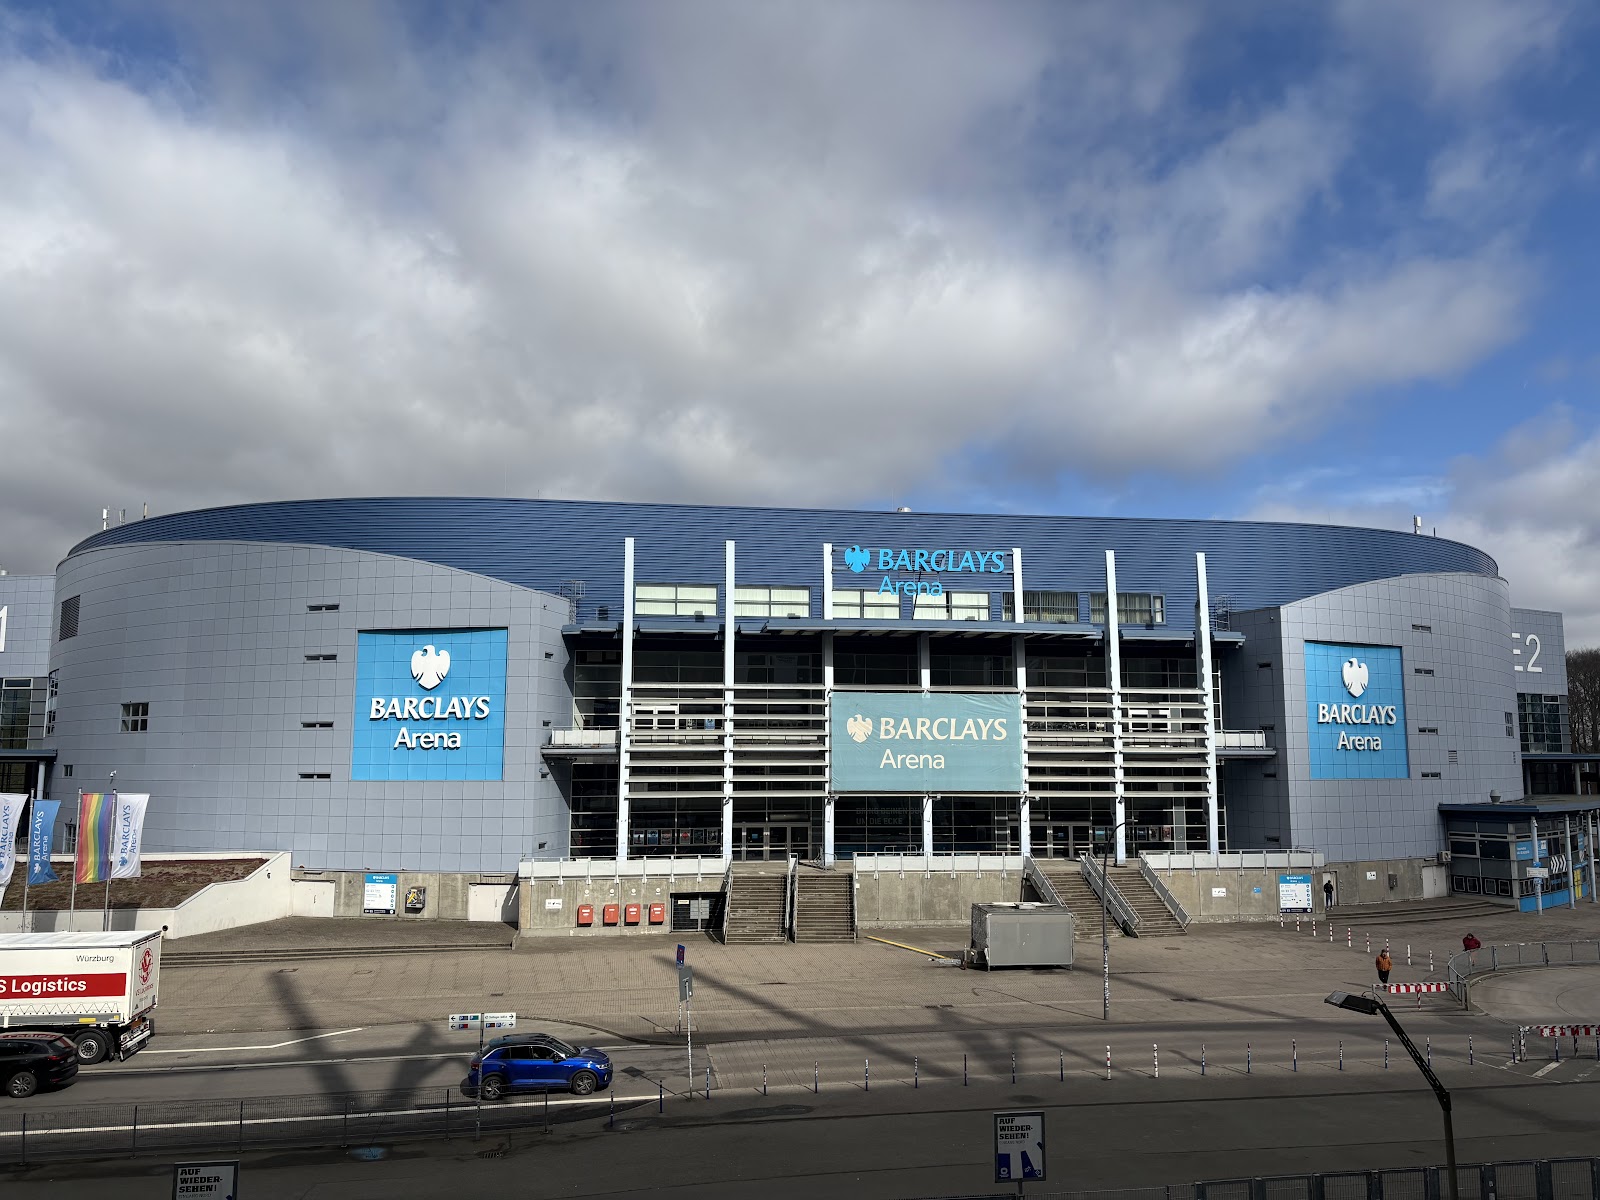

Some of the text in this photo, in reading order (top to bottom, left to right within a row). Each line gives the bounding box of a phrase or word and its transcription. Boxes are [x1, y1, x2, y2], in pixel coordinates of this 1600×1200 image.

[878, 549, 1005, 573] BARCLAYS
[877, 575, 943, 597] Arena
[369, 696, 491, 720] BARCLAYS
[1317, 703, 1397, 725] BARCLAYS
[394, 727, 461, 749] Arena
[879, 717, 1008, 741] BARCLAYS
[1337, 730, 1382, 750] Arena
[879, 748, 945, 769] Arena
[120, 804, 131, 854] BARCLAYS
[883, 817, 903, 825] ECKE
[34, 810, 45, 861] BARCLAYS
[76, 955, 115, 963] Würzburg
[12, 977, 87, 996] Logistics
[999, 1124, 1033, 1132] WIEDER-
[999, 1132, 1029, 1140] SEHEN!
[178, 1184, 217, 1193] SEHEN!
[180, 1176, 223, 1184] WIEDER-
